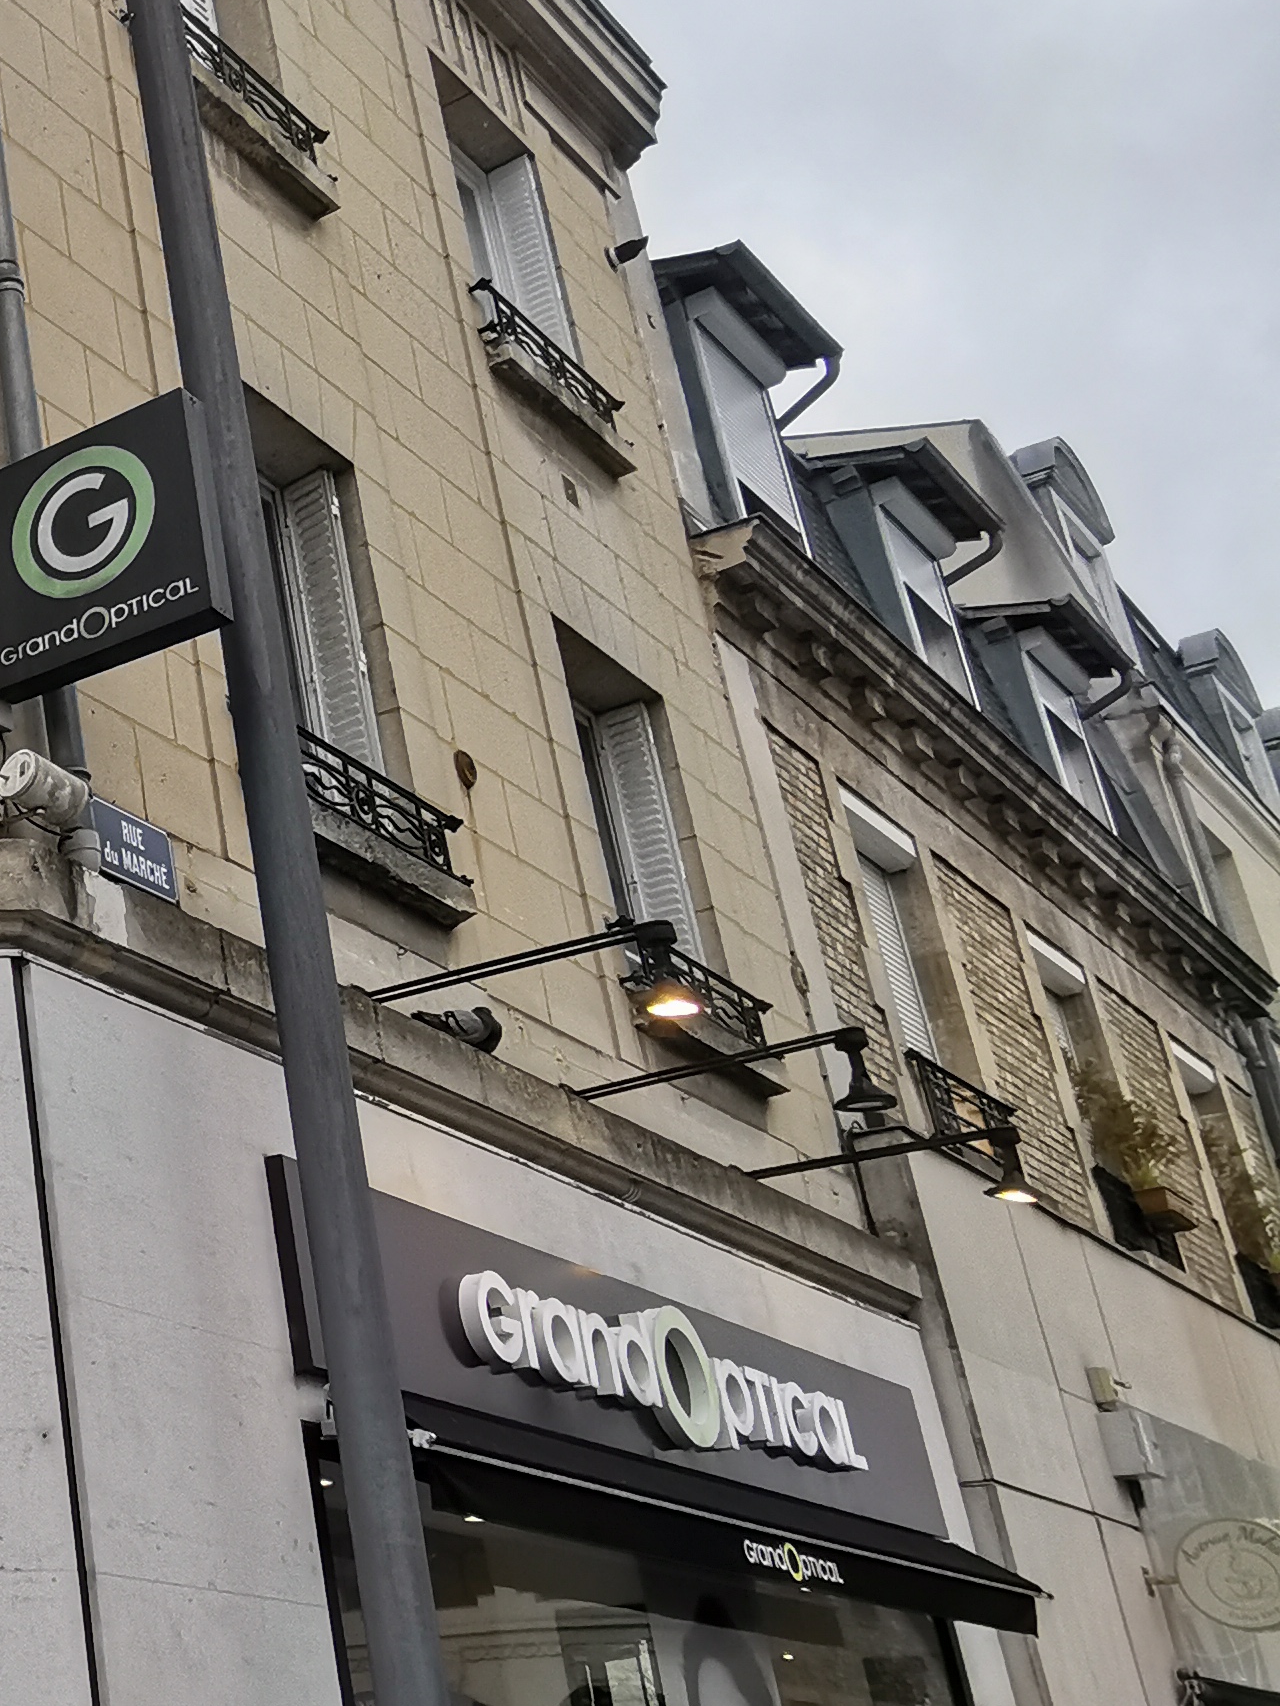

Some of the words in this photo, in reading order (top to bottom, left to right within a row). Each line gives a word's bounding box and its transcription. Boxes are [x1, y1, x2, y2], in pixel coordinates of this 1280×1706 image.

[120, 819, 146, 850] RUE
[103, 840, 120, 866] du
[121, 847, 171, 890] MARCHÉ
